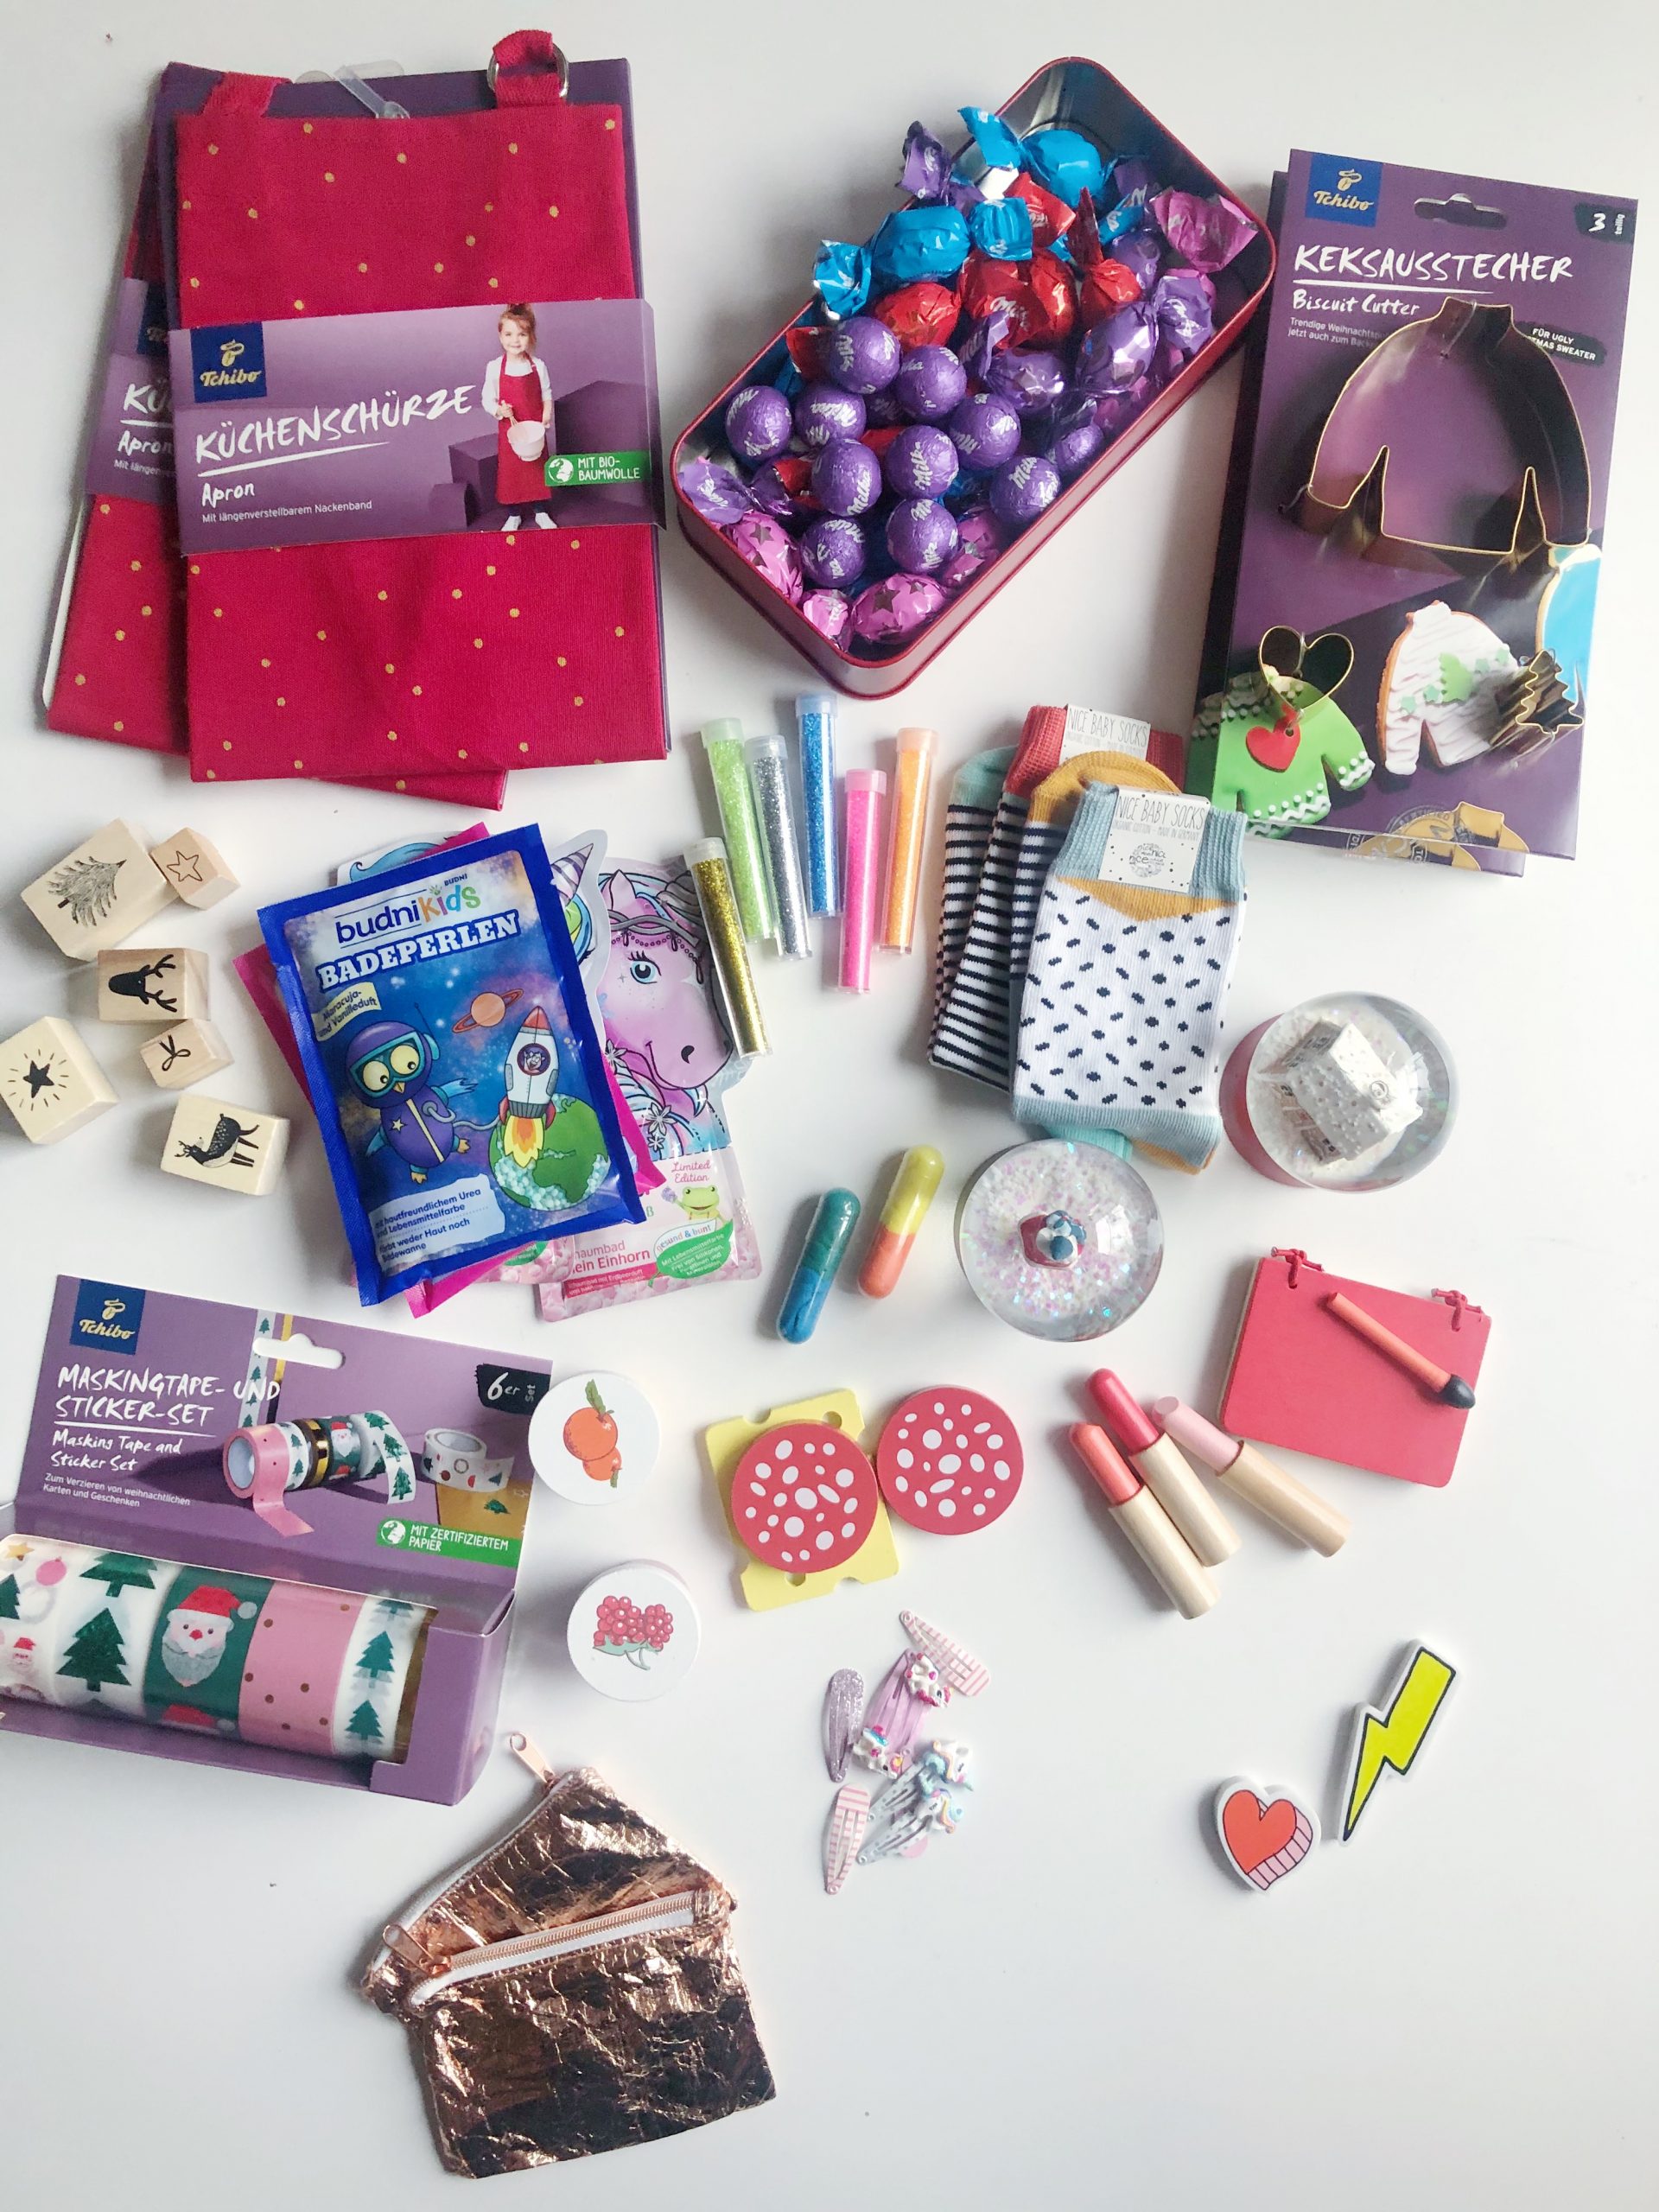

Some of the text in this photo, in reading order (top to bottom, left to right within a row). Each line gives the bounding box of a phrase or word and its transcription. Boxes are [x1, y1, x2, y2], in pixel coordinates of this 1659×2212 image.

[1313, 190, 1374, 212] Tchibo
[1588, 213, 1605, 232] 3
[1294, 243, 1573, 283] KEKSAUSSTECHER
[1293, 289, 1420, 316] Biscuit Cutter
[1287, 327, 1307, 337] jetzt
[1308, 330, 1329, 341] auch
[1331, 336, 1349, 345] zum
[1290, 317, 1326, 332] Trendige
[1532, 327, 1573, 345] FÜR UGLY
[1556, 344, 1596, 361] SWEATER
[200, 369, 261, 386] Tchibo
[196, 385, 475, 464] KÜCHENSCHÜRZE
[577, 456, 620, 469] MIT BIO-
[578, 467, 640, 481] BAUMWOLLE
[201, 482, 255, 508] Apron
[847, 470, 871, 517] Milka
[202, 500, 372, 523] Mit längenverstellbarem Nackenband
[1068, 708, 1088, 733] NICE
[1090, 714, 1116, 741] BABY
[1118, 723, 1147, 747] SOCKS
[1117, 796, 1205, 830] NICE BABY SOCKS
[319, 912, 518, 988] BADEPERLEN
[323, 991, 361, 1020] Maracuja-
[333, 997, 377, 1026] Vanilleduft
[671, 1160, 710, 1172] Limited
[675, 1173, 709, 1183] Edition
[384, 1195, 457, 1224] hautfreundlichem
[459, 1189, 481, 1199] Urea
[389, 1204, 465, 1232] Lebensmittelfarbe
[397, 1233, 423, 1247] weder
[425, 1225, 448, 1237] Haut
[448, 1218, 470, 1230] noch
[692, 1224, 711, 1235] bunt
[597, 1249, 651, 1269] Einhorn
[79, 1319, 135, 1339] Tchibo
[57, 1363, 280, 1400] MASKINGTAPE- UND
[524, 1384, 536, 1402] Set
[55, 1395, 214, 1427] STICKER-SET
[52, 1428, 183, 1454] Masking Tape and
[50, 1451, 138, 1471] Sticker Set
[43, 1483, 141, 1508] Karten und Geschenken
[44, 1472, 191, 1506] Zum Verzieren von weihnachtlichen
[409, 1536, 442, 1552] PAPIER
[410, 1525, 508, 1551] MIT ZERTIFIZIERTEM
